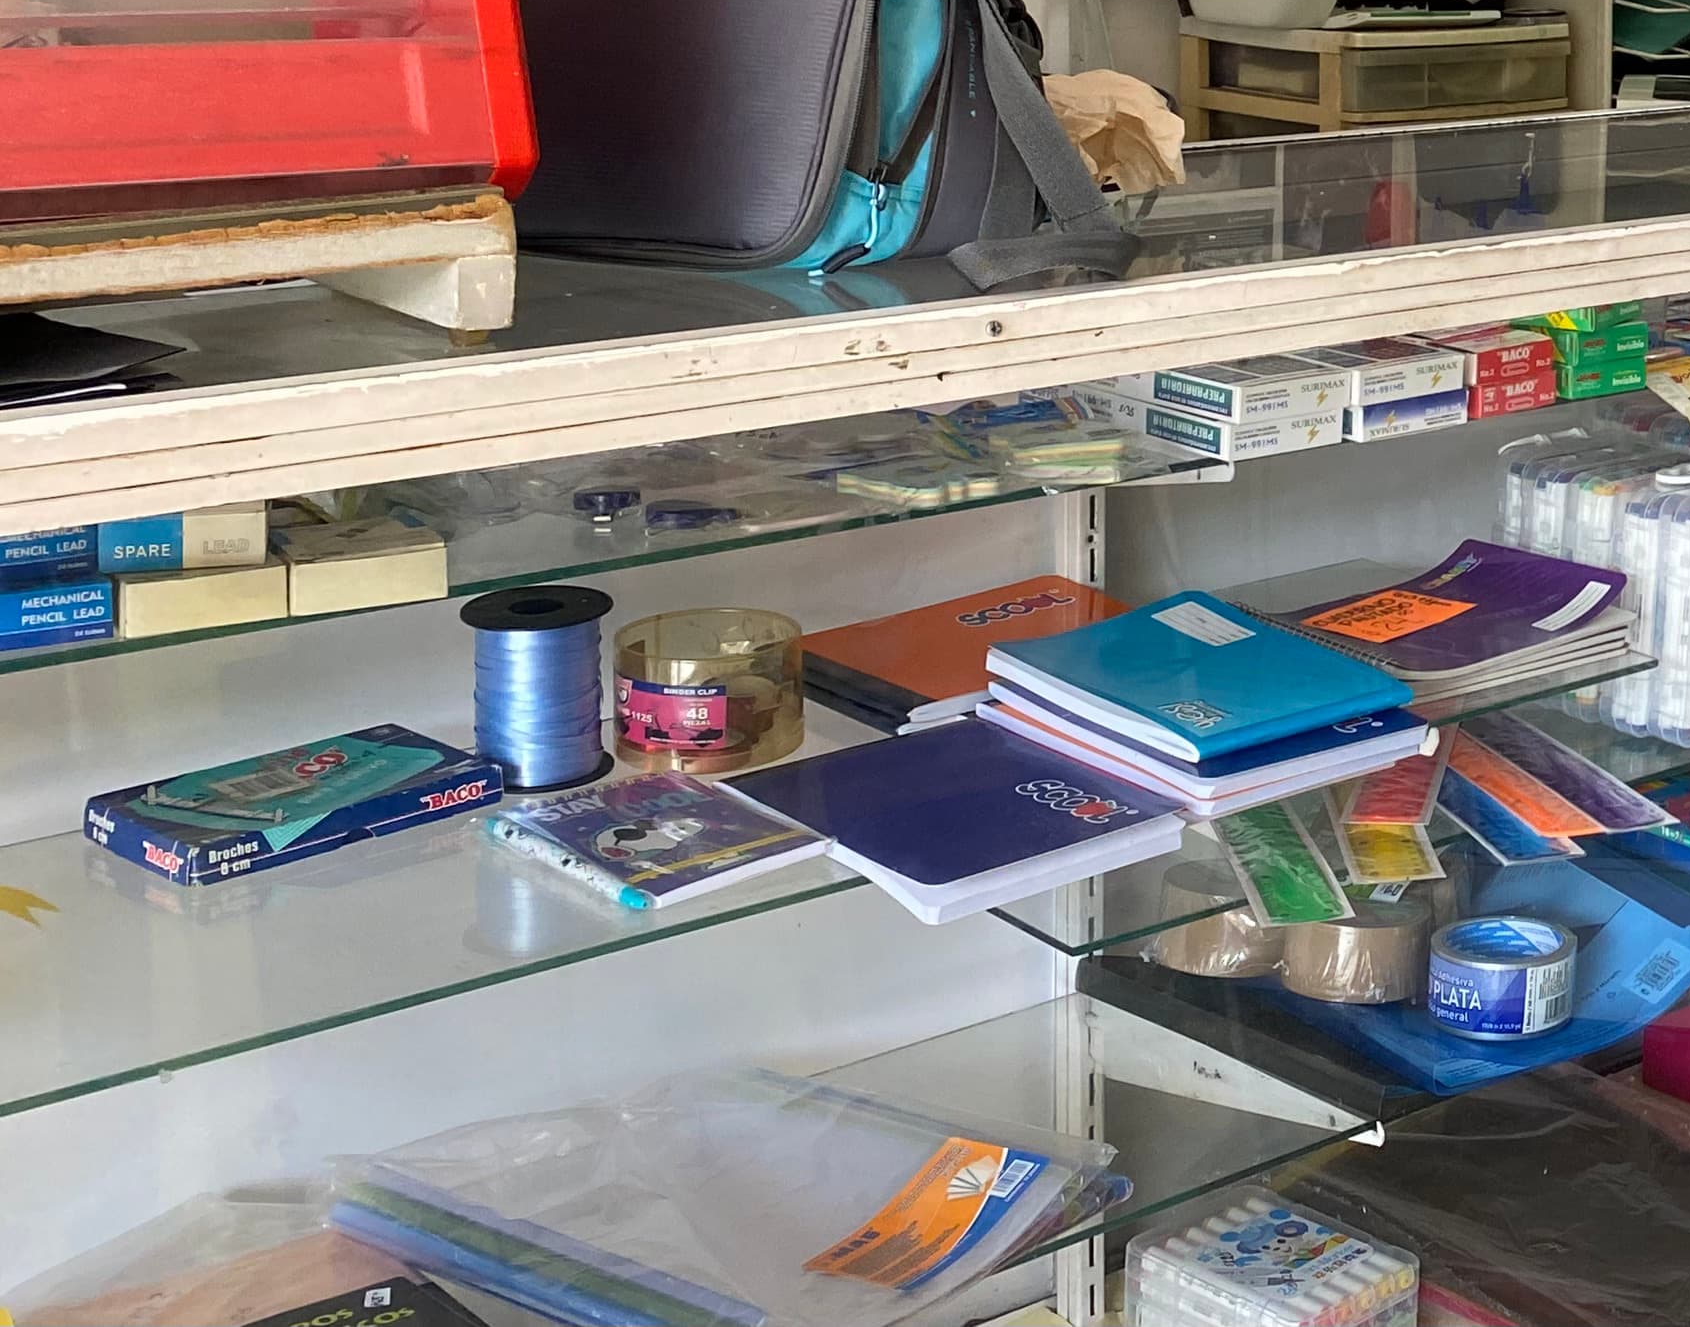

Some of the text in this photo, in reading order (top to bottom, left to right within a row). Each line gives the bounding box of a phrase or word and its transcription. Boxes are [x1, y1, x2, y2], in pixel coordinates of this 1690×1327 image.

[1616, 340, 1645, 352] Invisible
[1416, 361, 1458, 376] SURIMAX
[1301, 378, 1345, 393] SURIMAX
[1612, 373, 1642, 387] Invisible
[1291, 414, 1337, 430] SURIMAX
[5, 539, 88, 560] PENCIL LEAD
[113, 543, 172, 560] SPARE
[202, 537, 251, 555] LEAD
[21, 589, 105, 609] MECHANICAL
[21, 605, 105, 627] PENCIL LEAD
[663, 687, 718, 696] BINDER CLIP
[631, 710, 653, 724] 1125
[686, 707, 709, 720] 48
[208, 840, 260, 865] Broches
[220, 857, 252, 875] 8 cm
[1433, 981, 1482, 1011] PLATA
[1436, 1007, 1469, 1023] general
